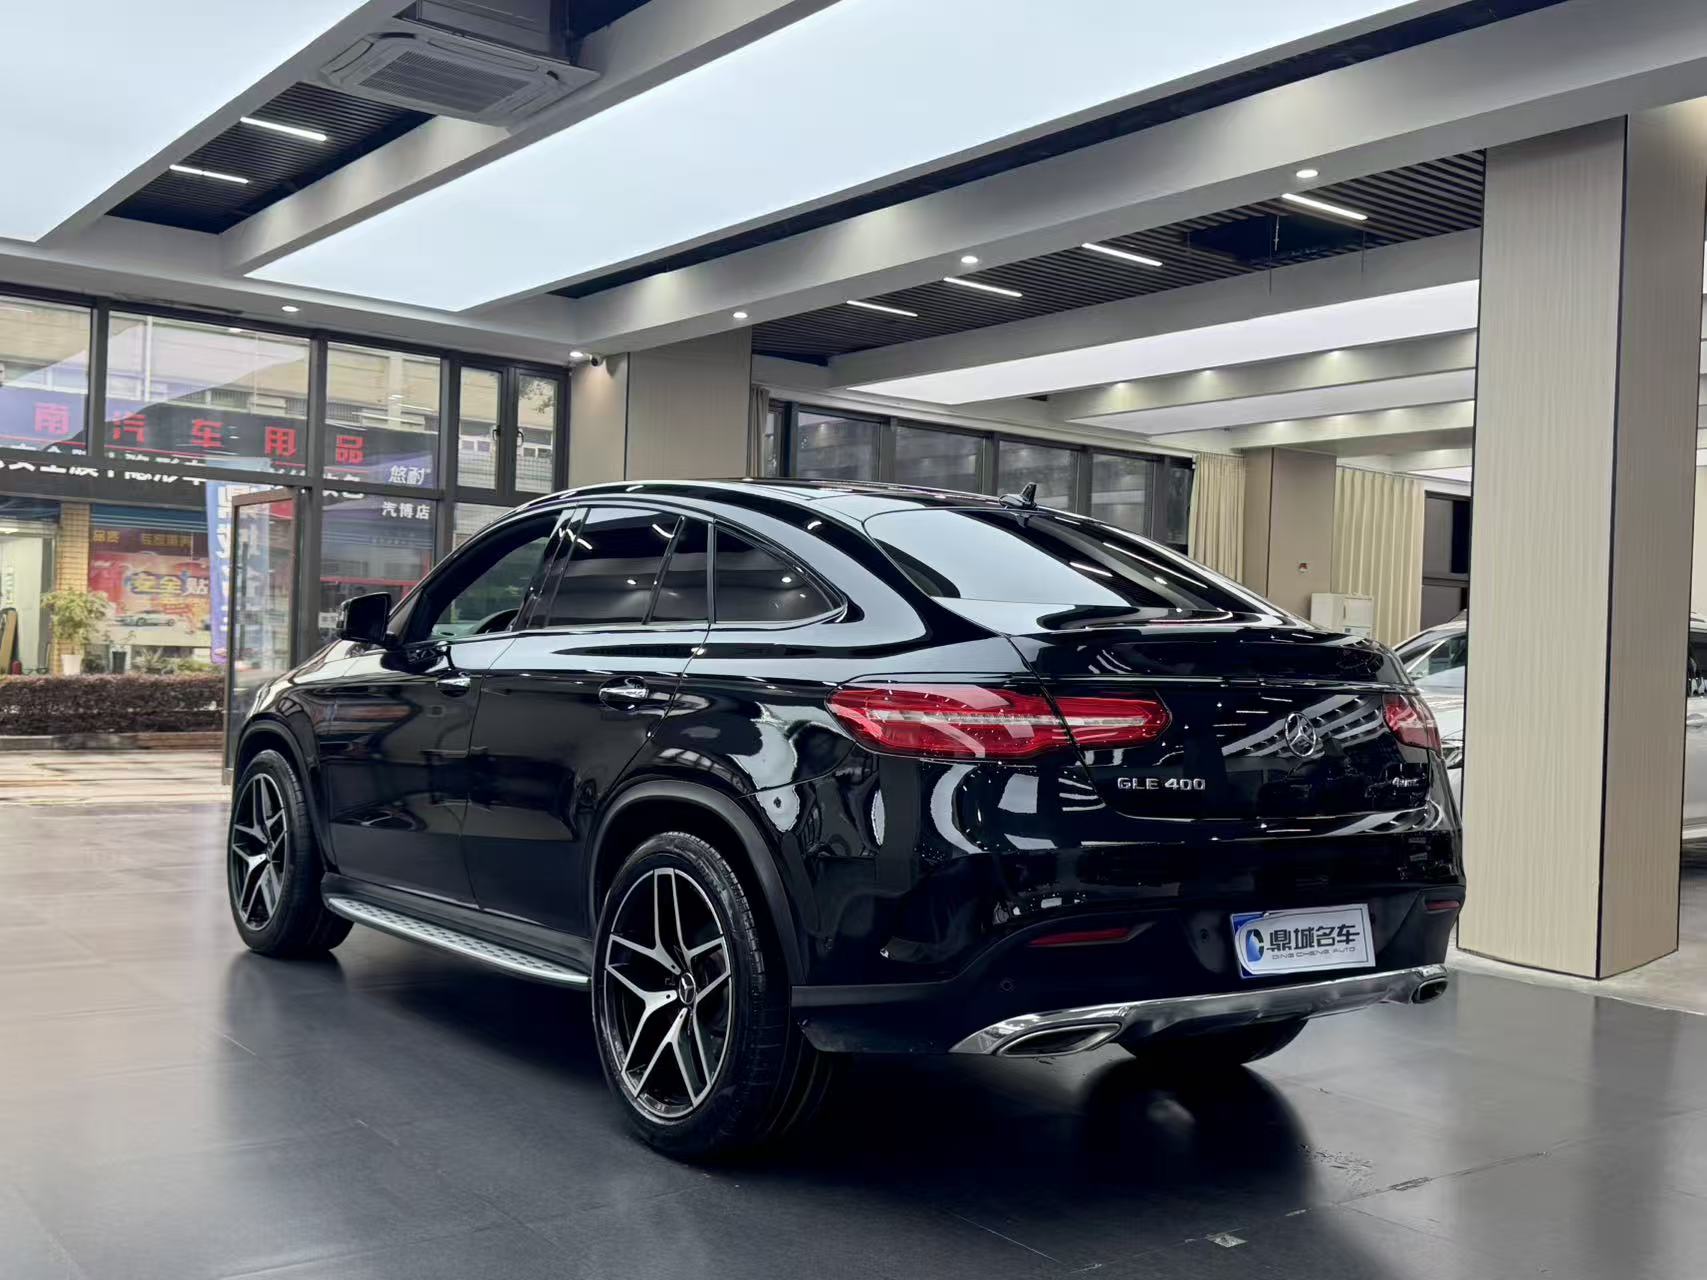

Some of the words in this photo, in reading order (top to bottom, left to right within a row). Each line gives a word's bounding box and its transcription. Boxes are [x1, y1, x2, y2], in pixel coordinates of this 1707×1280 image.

[381, 501, 430, 520] 汽博店
[1117, 777, 1159, 790] GLE
[1164, 778, 1206, 791] 400
[1266, 924, 1360, 952] 鼎城名车
